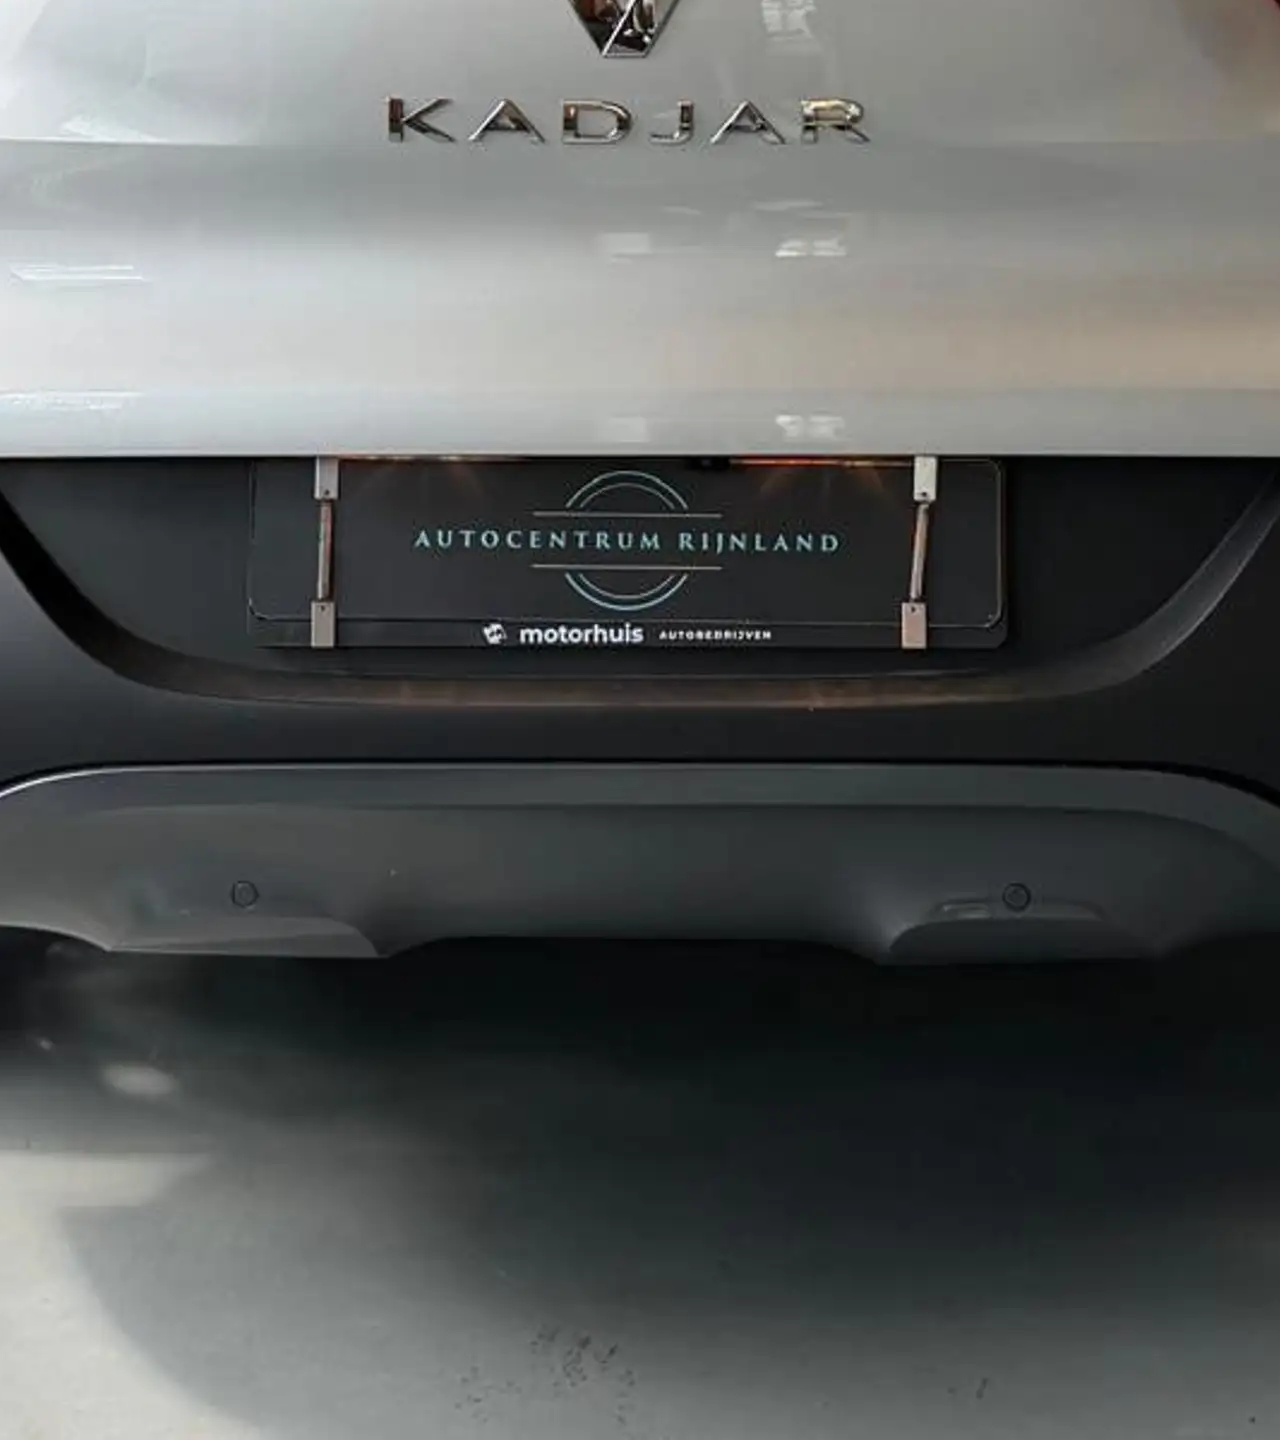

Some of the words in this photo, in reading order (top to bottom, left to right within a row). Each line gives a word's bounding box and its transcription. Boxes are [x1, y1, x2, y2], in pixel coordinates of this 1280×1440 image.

[385, 96, 872, 145] KADJAR
[413, 528, 661, 550] AUTOCENTRUM
[678, 532, 840, 554] RIJNLAND
[519, 622, 644, 645] motorhuis
[658, 629, 773, 641] AUTOBEDRIJVEN
